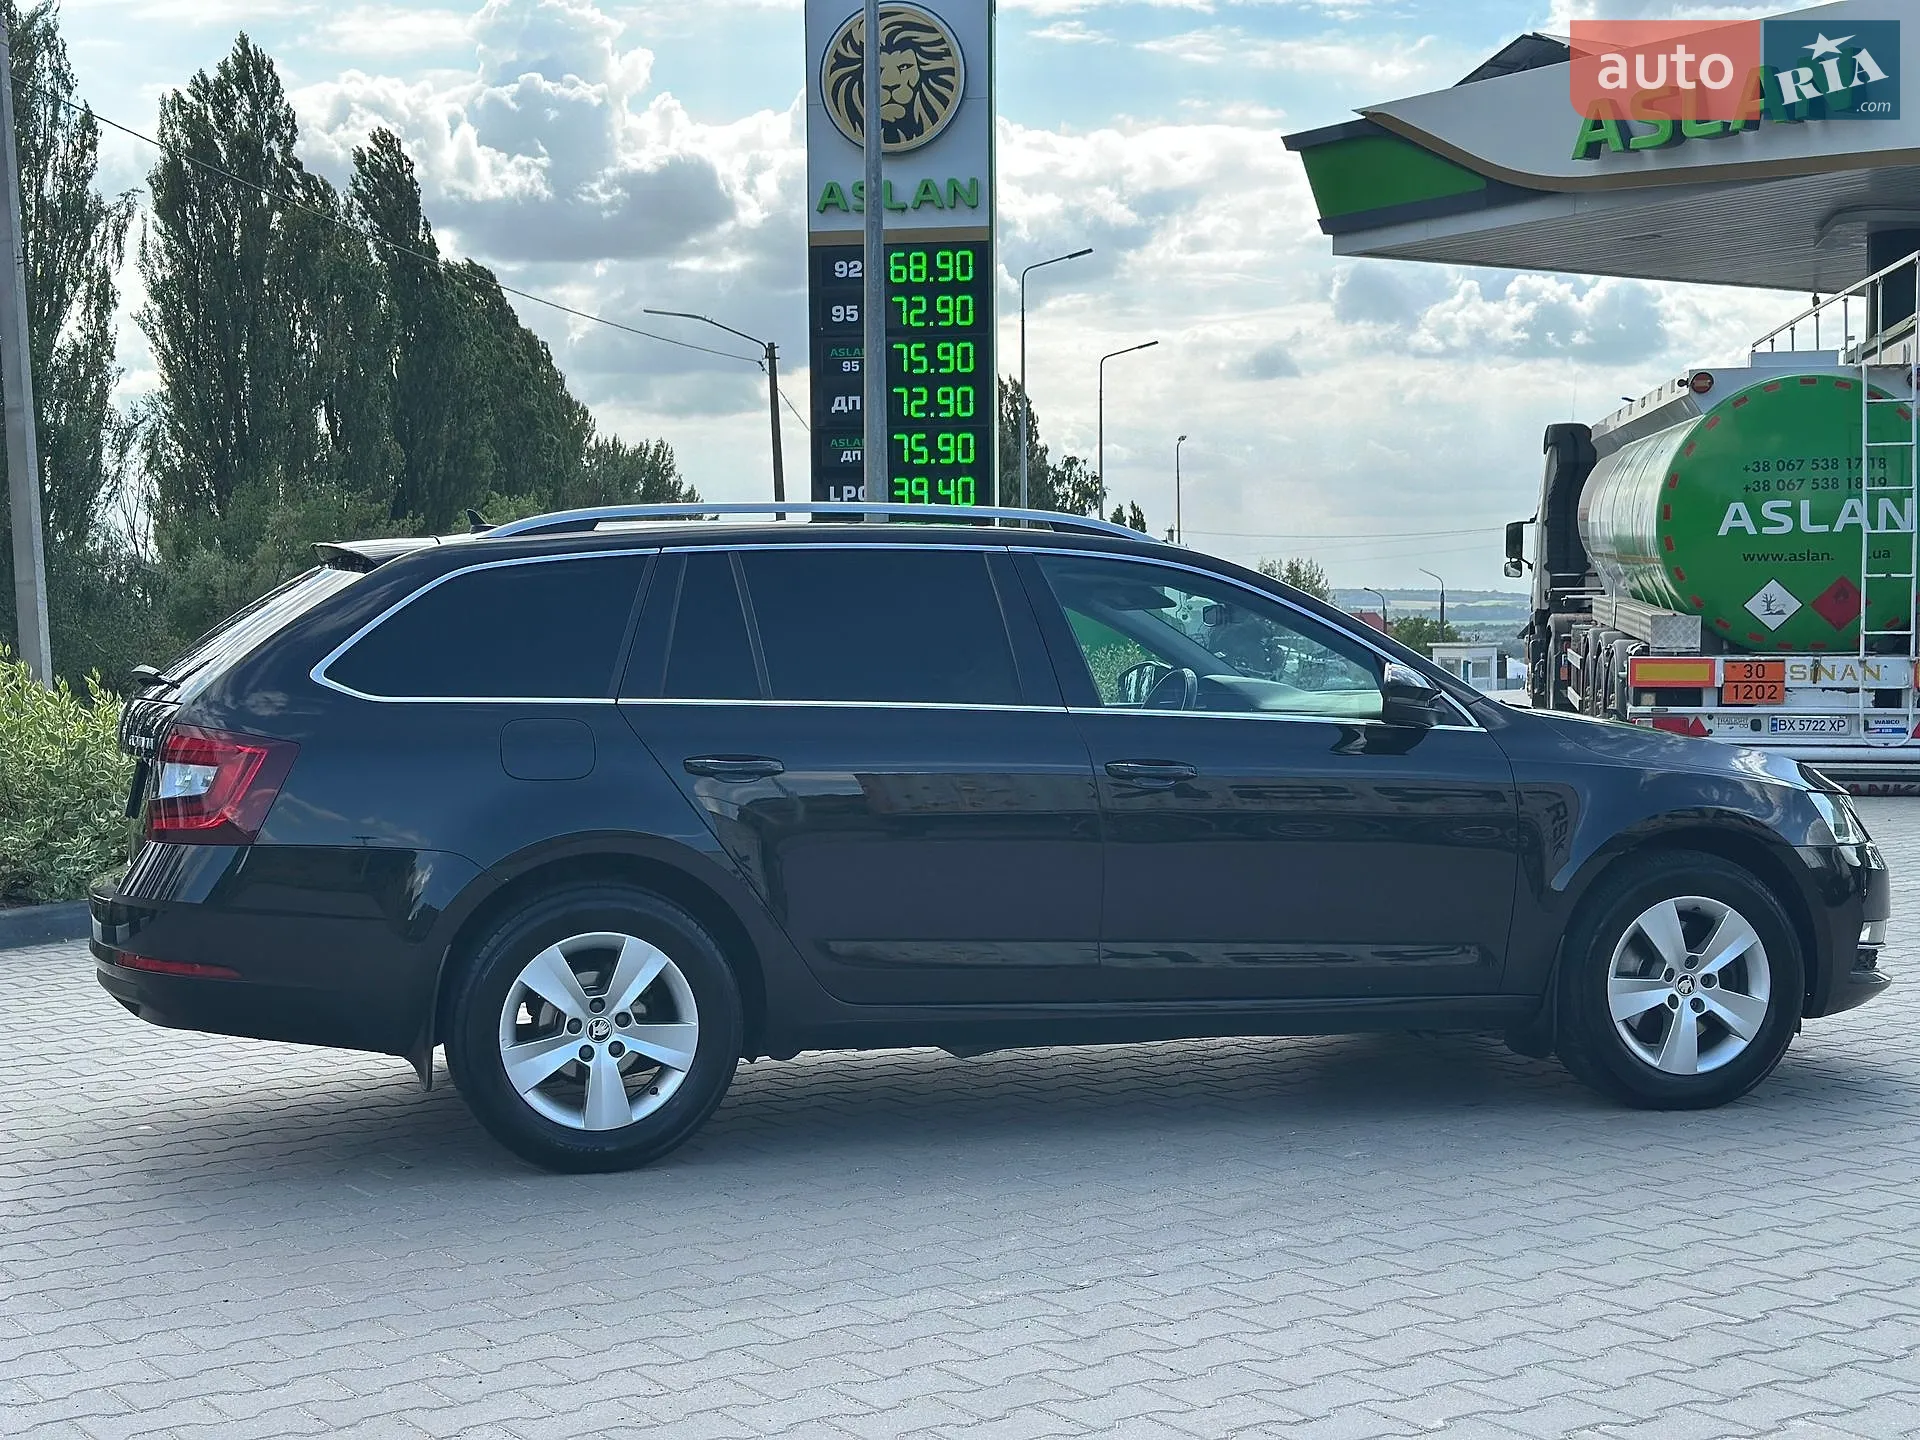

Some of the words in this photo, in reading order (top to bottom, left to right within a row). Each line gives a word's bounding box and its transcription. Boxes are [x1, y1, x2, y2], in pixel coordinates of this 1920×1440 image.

[1571, 47, 1857, 160] ASLAN
[834, 260, 863, 278] 92
[889, 250, 974, 283] 68.90
[831, 305, 859, 322] 95
[891, 295, 974, 327] 72.90
[842, 360, 860, 372] 95
[893, 342, 975, 374] 75.90
[831, 395, 861, 413] ДП
[893, 386, 975, 418] 72.90
[840, 450, 862, 463] ДП
[893, 433, 975, 465] 75.90
[1743, 460, 1771, 473] +38
[1776, 459, 1805, 472] 067
[1810, 458, 1840, 471] 538
[1846, 457, 1864, 470] 17
[1869, 456, 1887, 469] 18
[1743, 479, 1771, 493] +38
[1776, 478, 1805, 491] 067
[1810, 477, 1840, 490] 538
[1847, 477, 1864, 489] 18
[1717, 497, 1912, 536] ASLAN
[1743, 663, 1766, 679] 30
[1733, 684, 1778, 700] 1202
[1778, 719, 1796, 731] BX
[1798, 719, 1826, 731] 5722
[1828, 719, 1846, 732] XP
